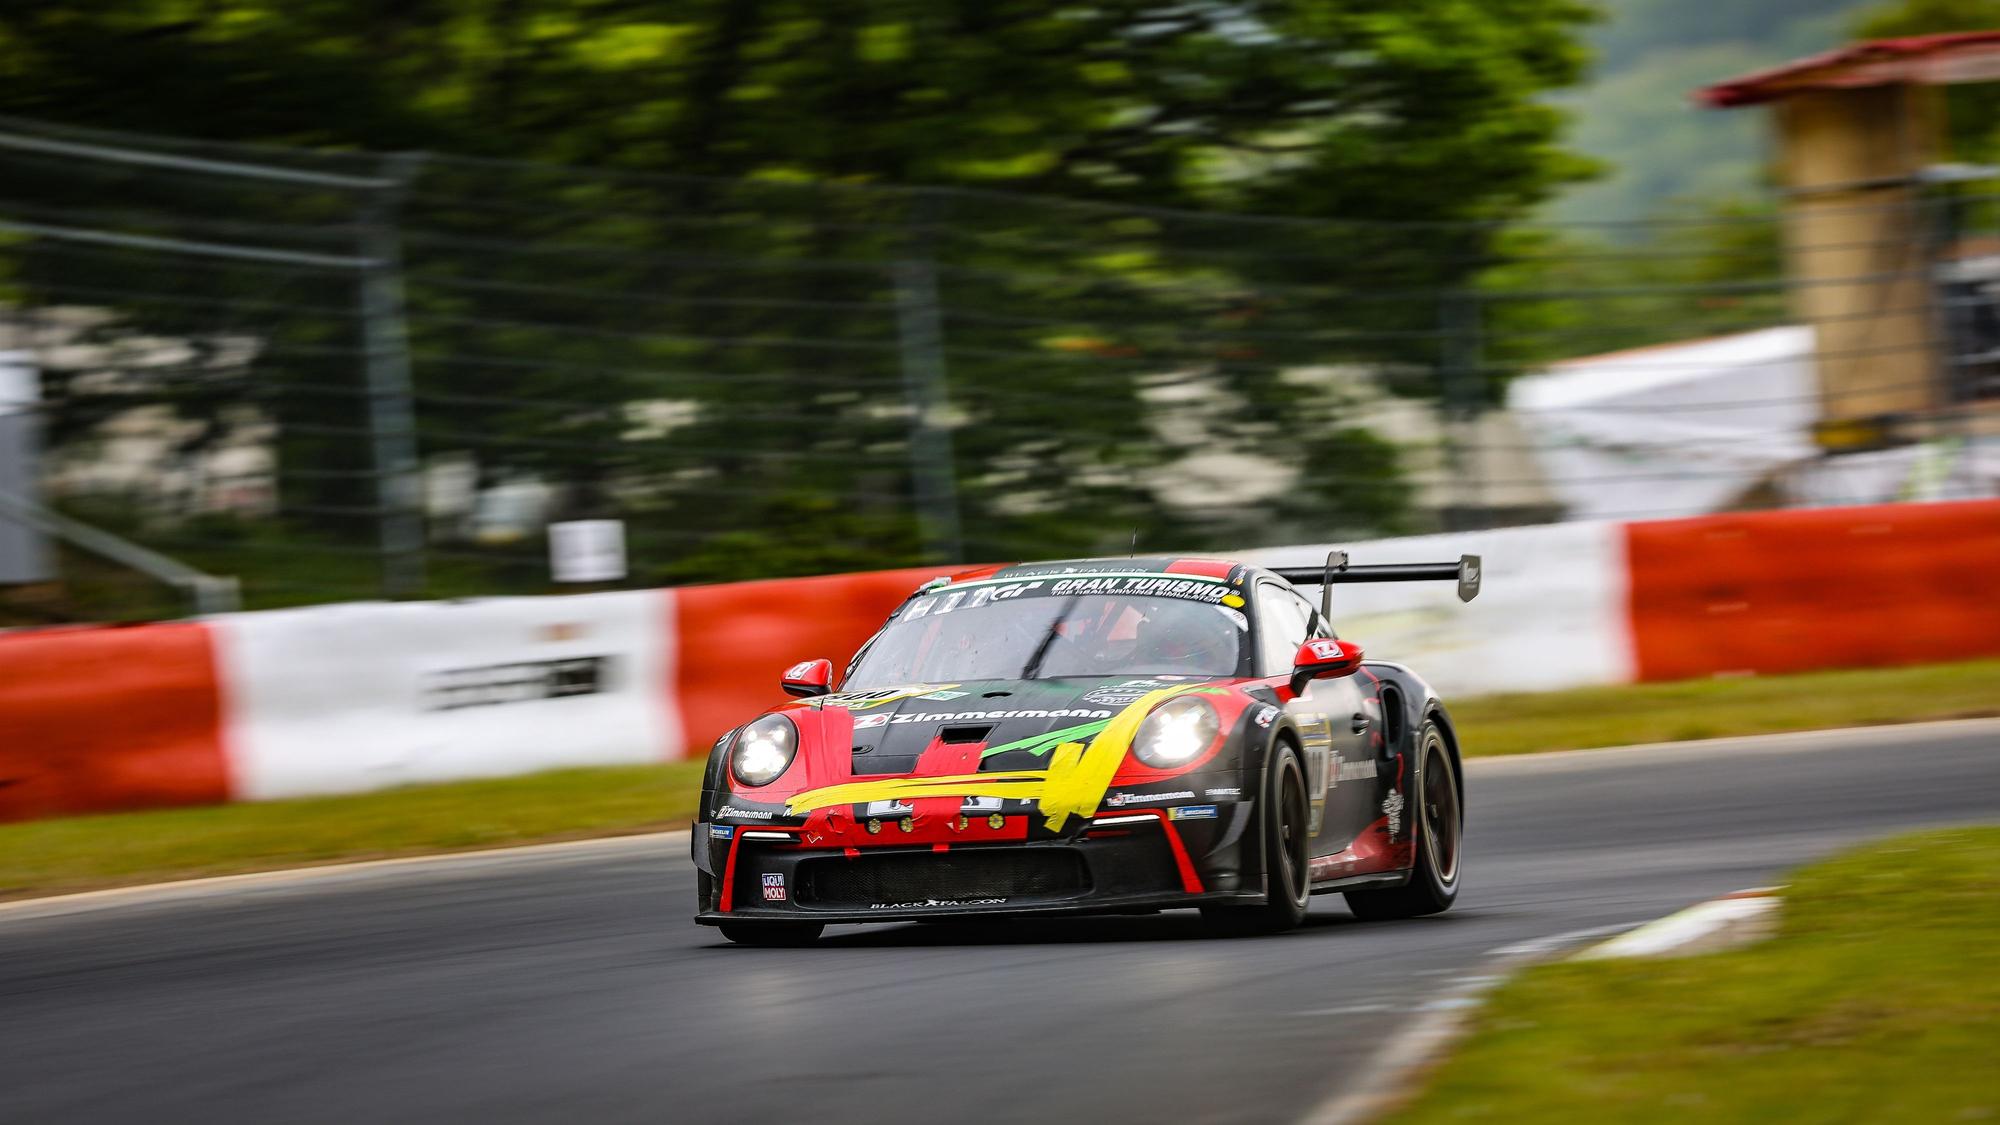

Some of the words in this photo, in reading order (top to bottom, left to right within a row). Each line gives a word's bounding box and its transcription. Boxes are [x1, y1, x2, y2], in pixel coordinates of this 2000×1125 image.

[1051, 578, 1121, 591] GRAN
[1123, 578, 1230, 598] TURISMO
[1106, 588, 1153, 596] DRIVING
[890, 709, 1112, 724] Zimmermann
[725, 807, 773, 819] Zimmermann
[764, 887, 785, 899] MOLY
[938, 898, 1007, 906] FALCON
